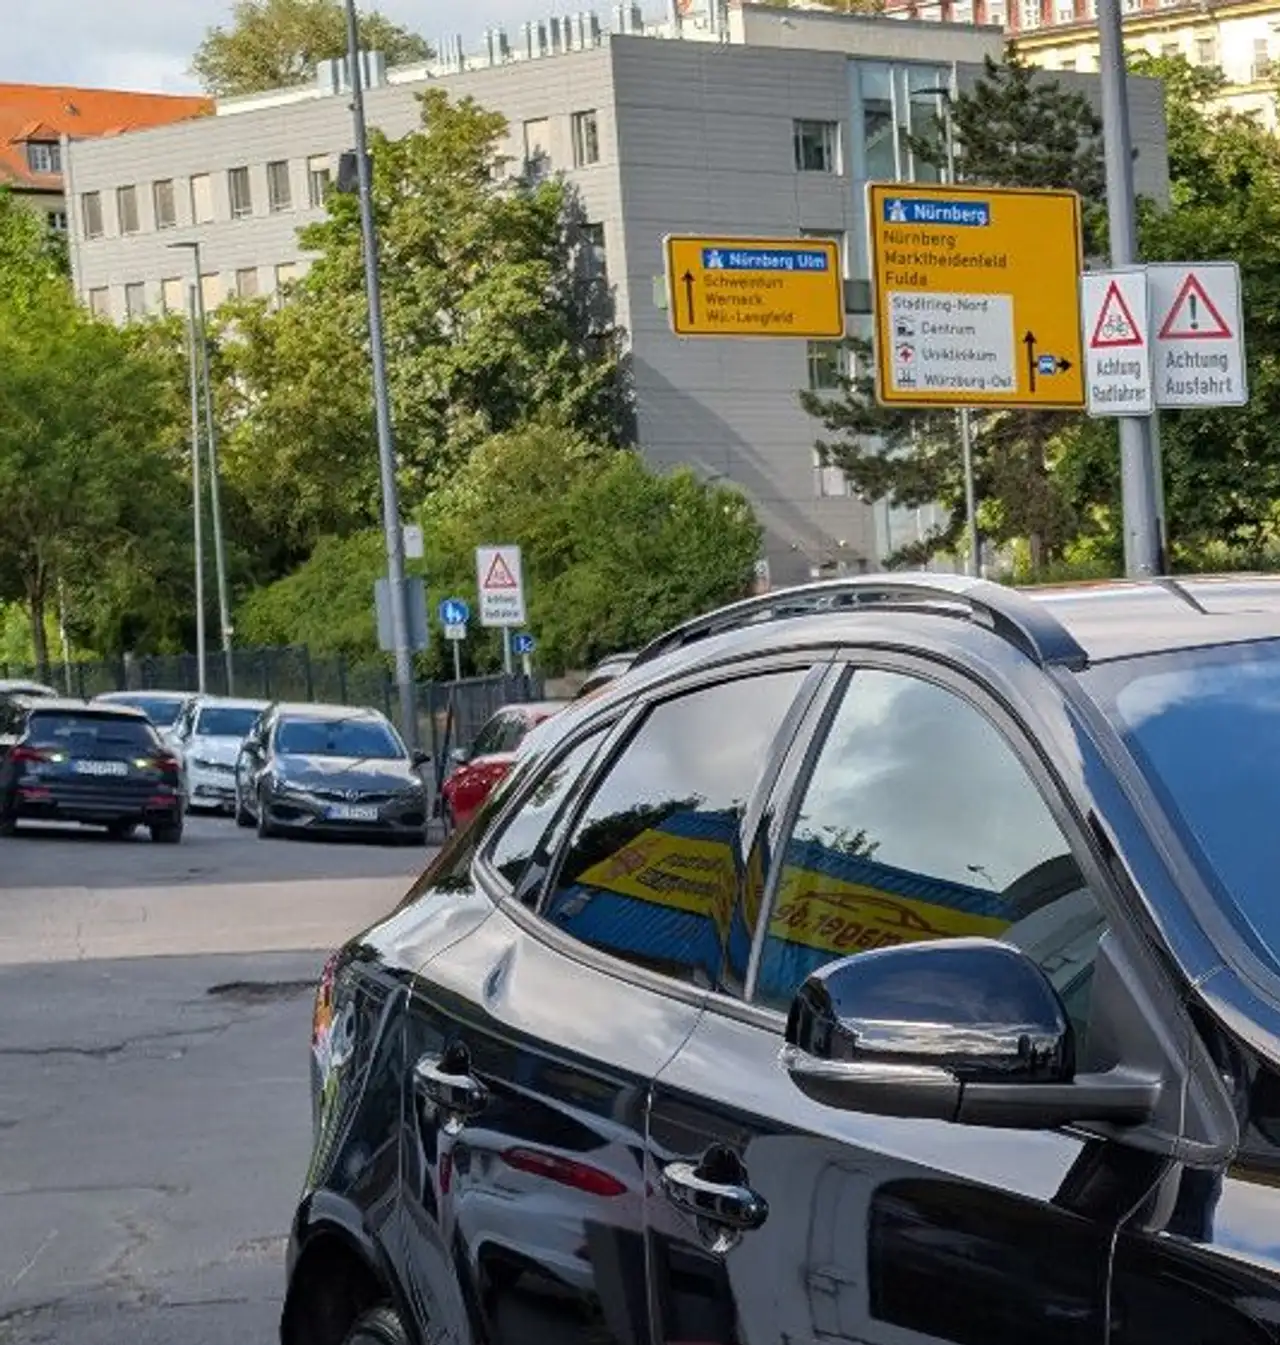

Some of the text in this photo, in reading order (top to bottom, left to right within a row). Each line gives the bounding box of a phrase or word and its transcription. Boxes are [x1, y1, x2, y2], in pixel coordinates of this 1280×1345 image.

[913, 204, 989, 224] Nürnberg
[883, 230, 957, 248] Nürnberg
[729, 252, 826, 269] Nürnberg Ulm
[885, 271, 929, 286] Fulda
[920, 321, 976, 336] Centrum
[1096, 358, 1141, 380] Achtung
[1165, 351, 1229, 373] Achtung
[1165, 376, 1234, 395] Ausfahrt
